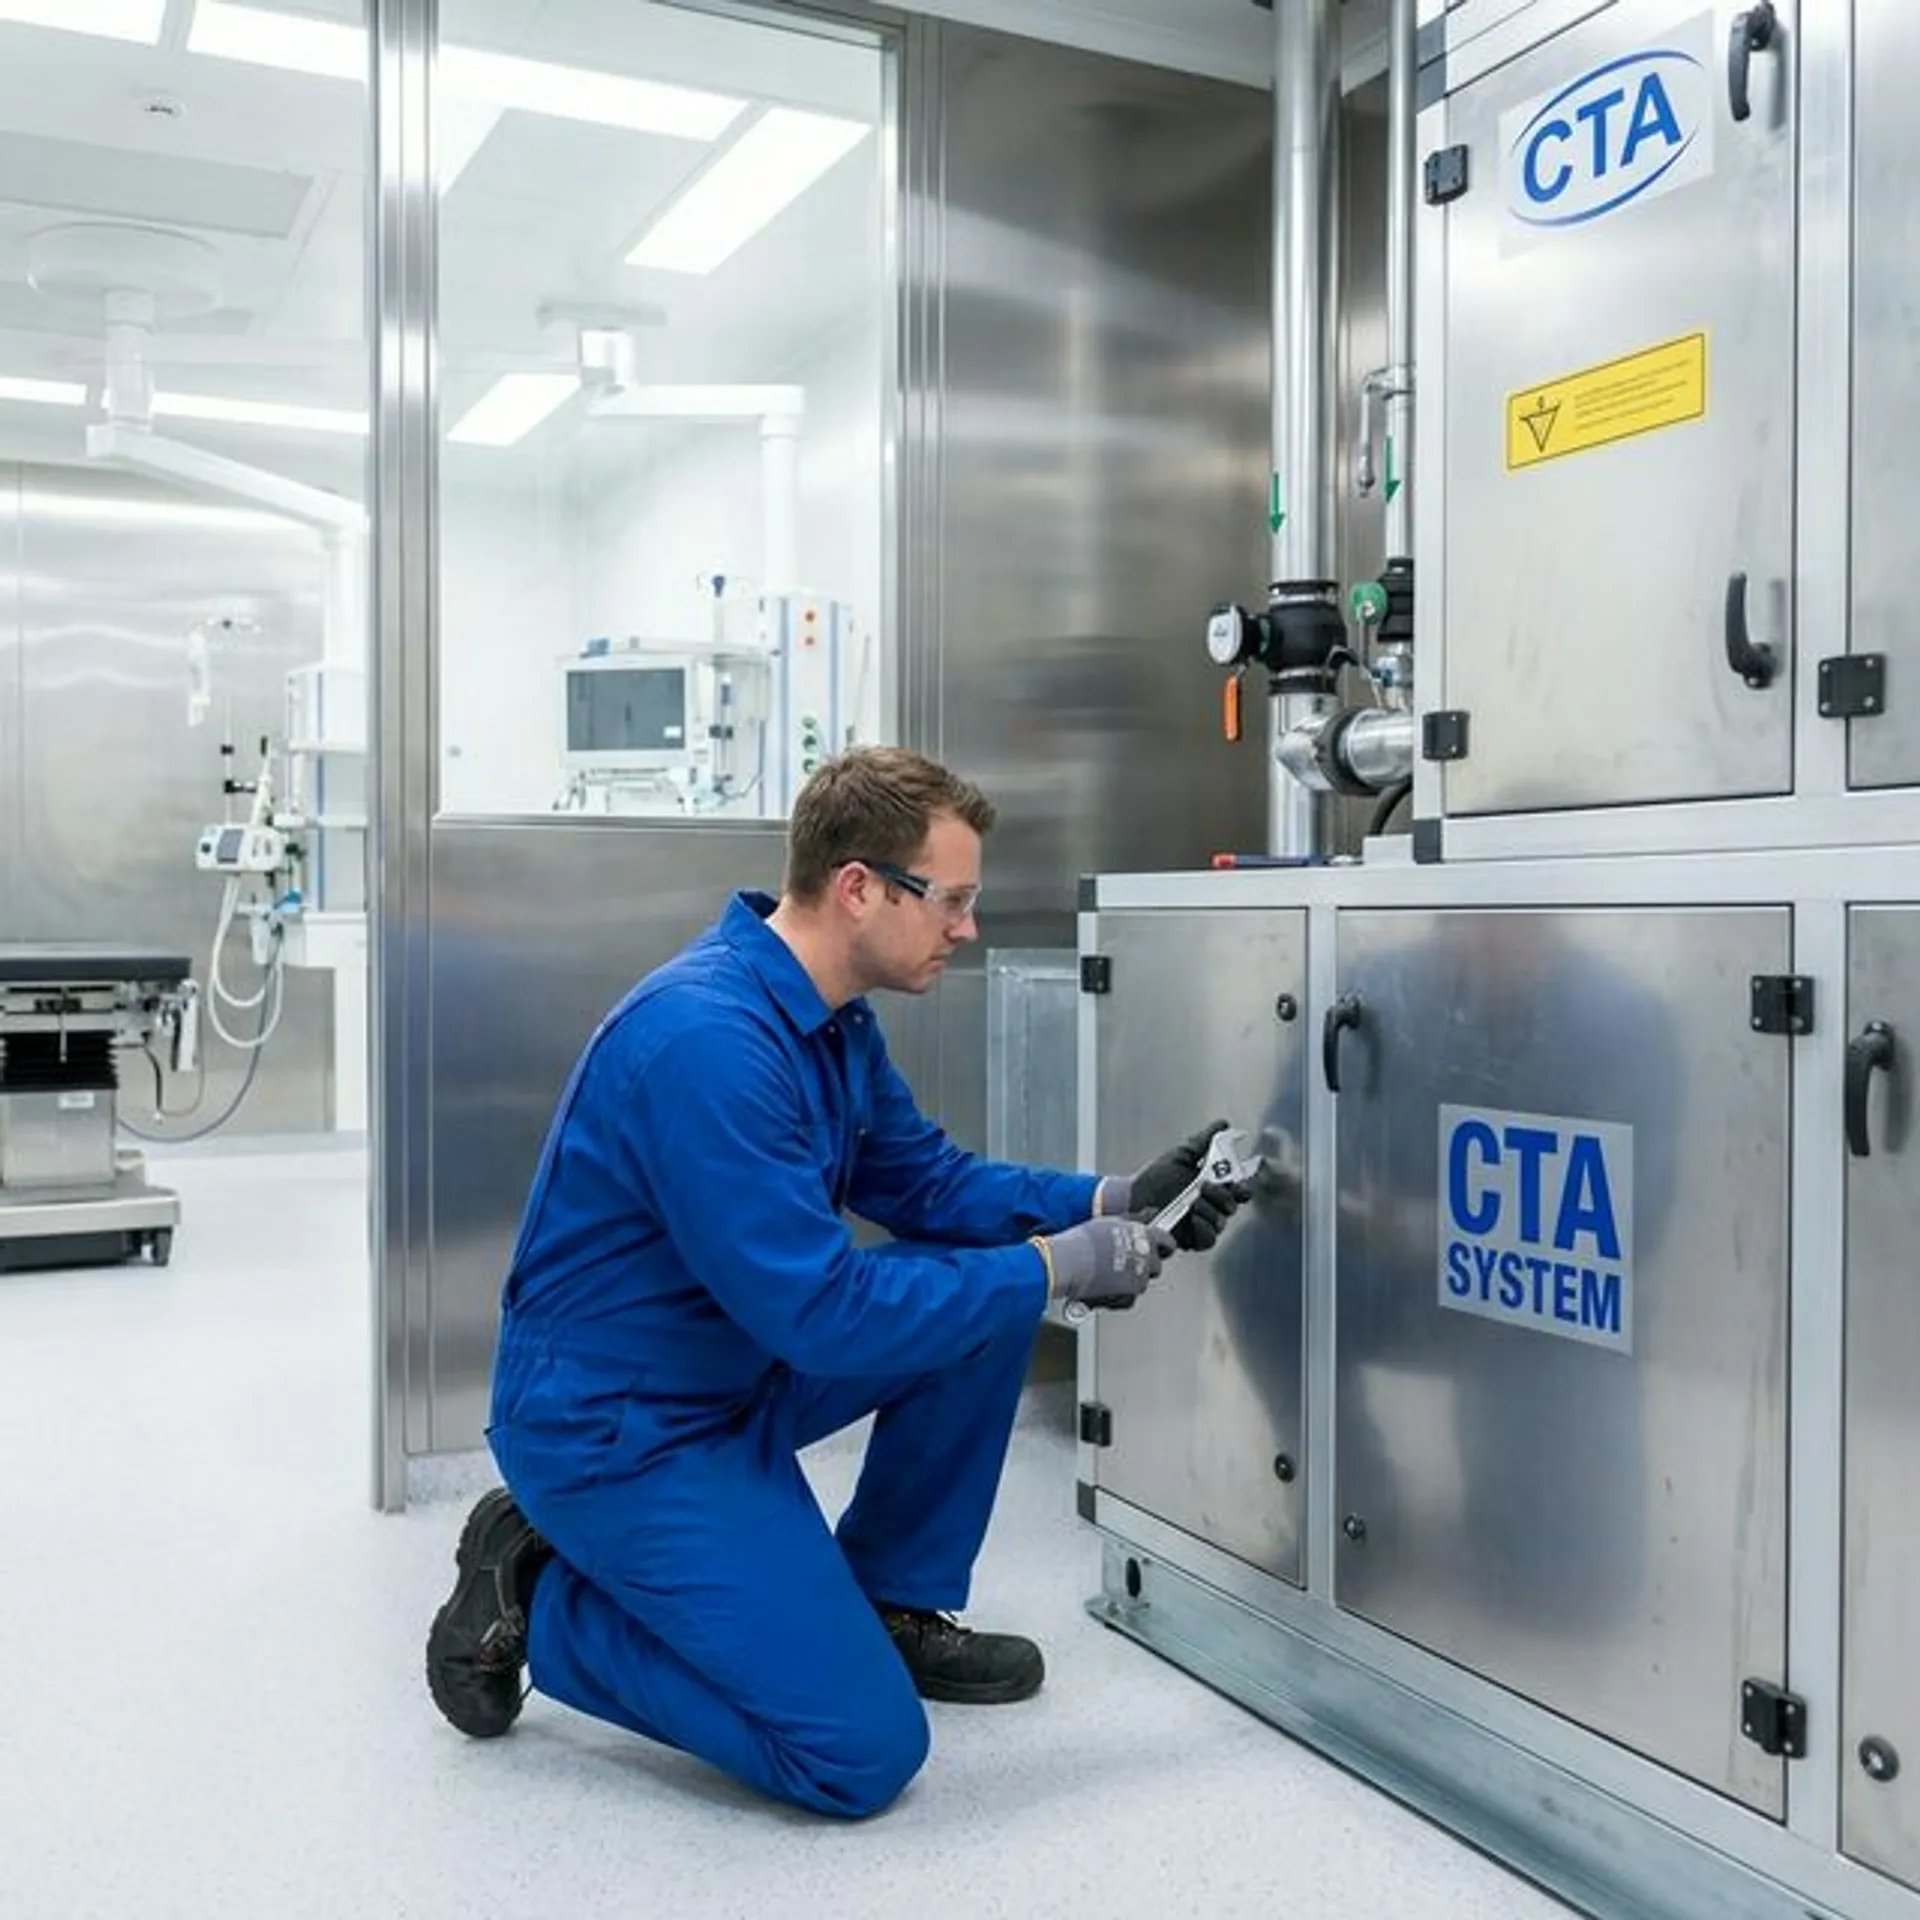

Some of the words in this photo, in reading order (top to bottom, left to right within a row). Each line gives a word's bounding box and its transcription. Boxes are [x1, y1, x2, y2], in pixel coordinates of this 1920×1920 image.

[1523, 72, 1682, 202] CTA
[1449, 1120, 1621, 1260] CTA
[1447, 1241, 1621, 1333] SYSTEM
